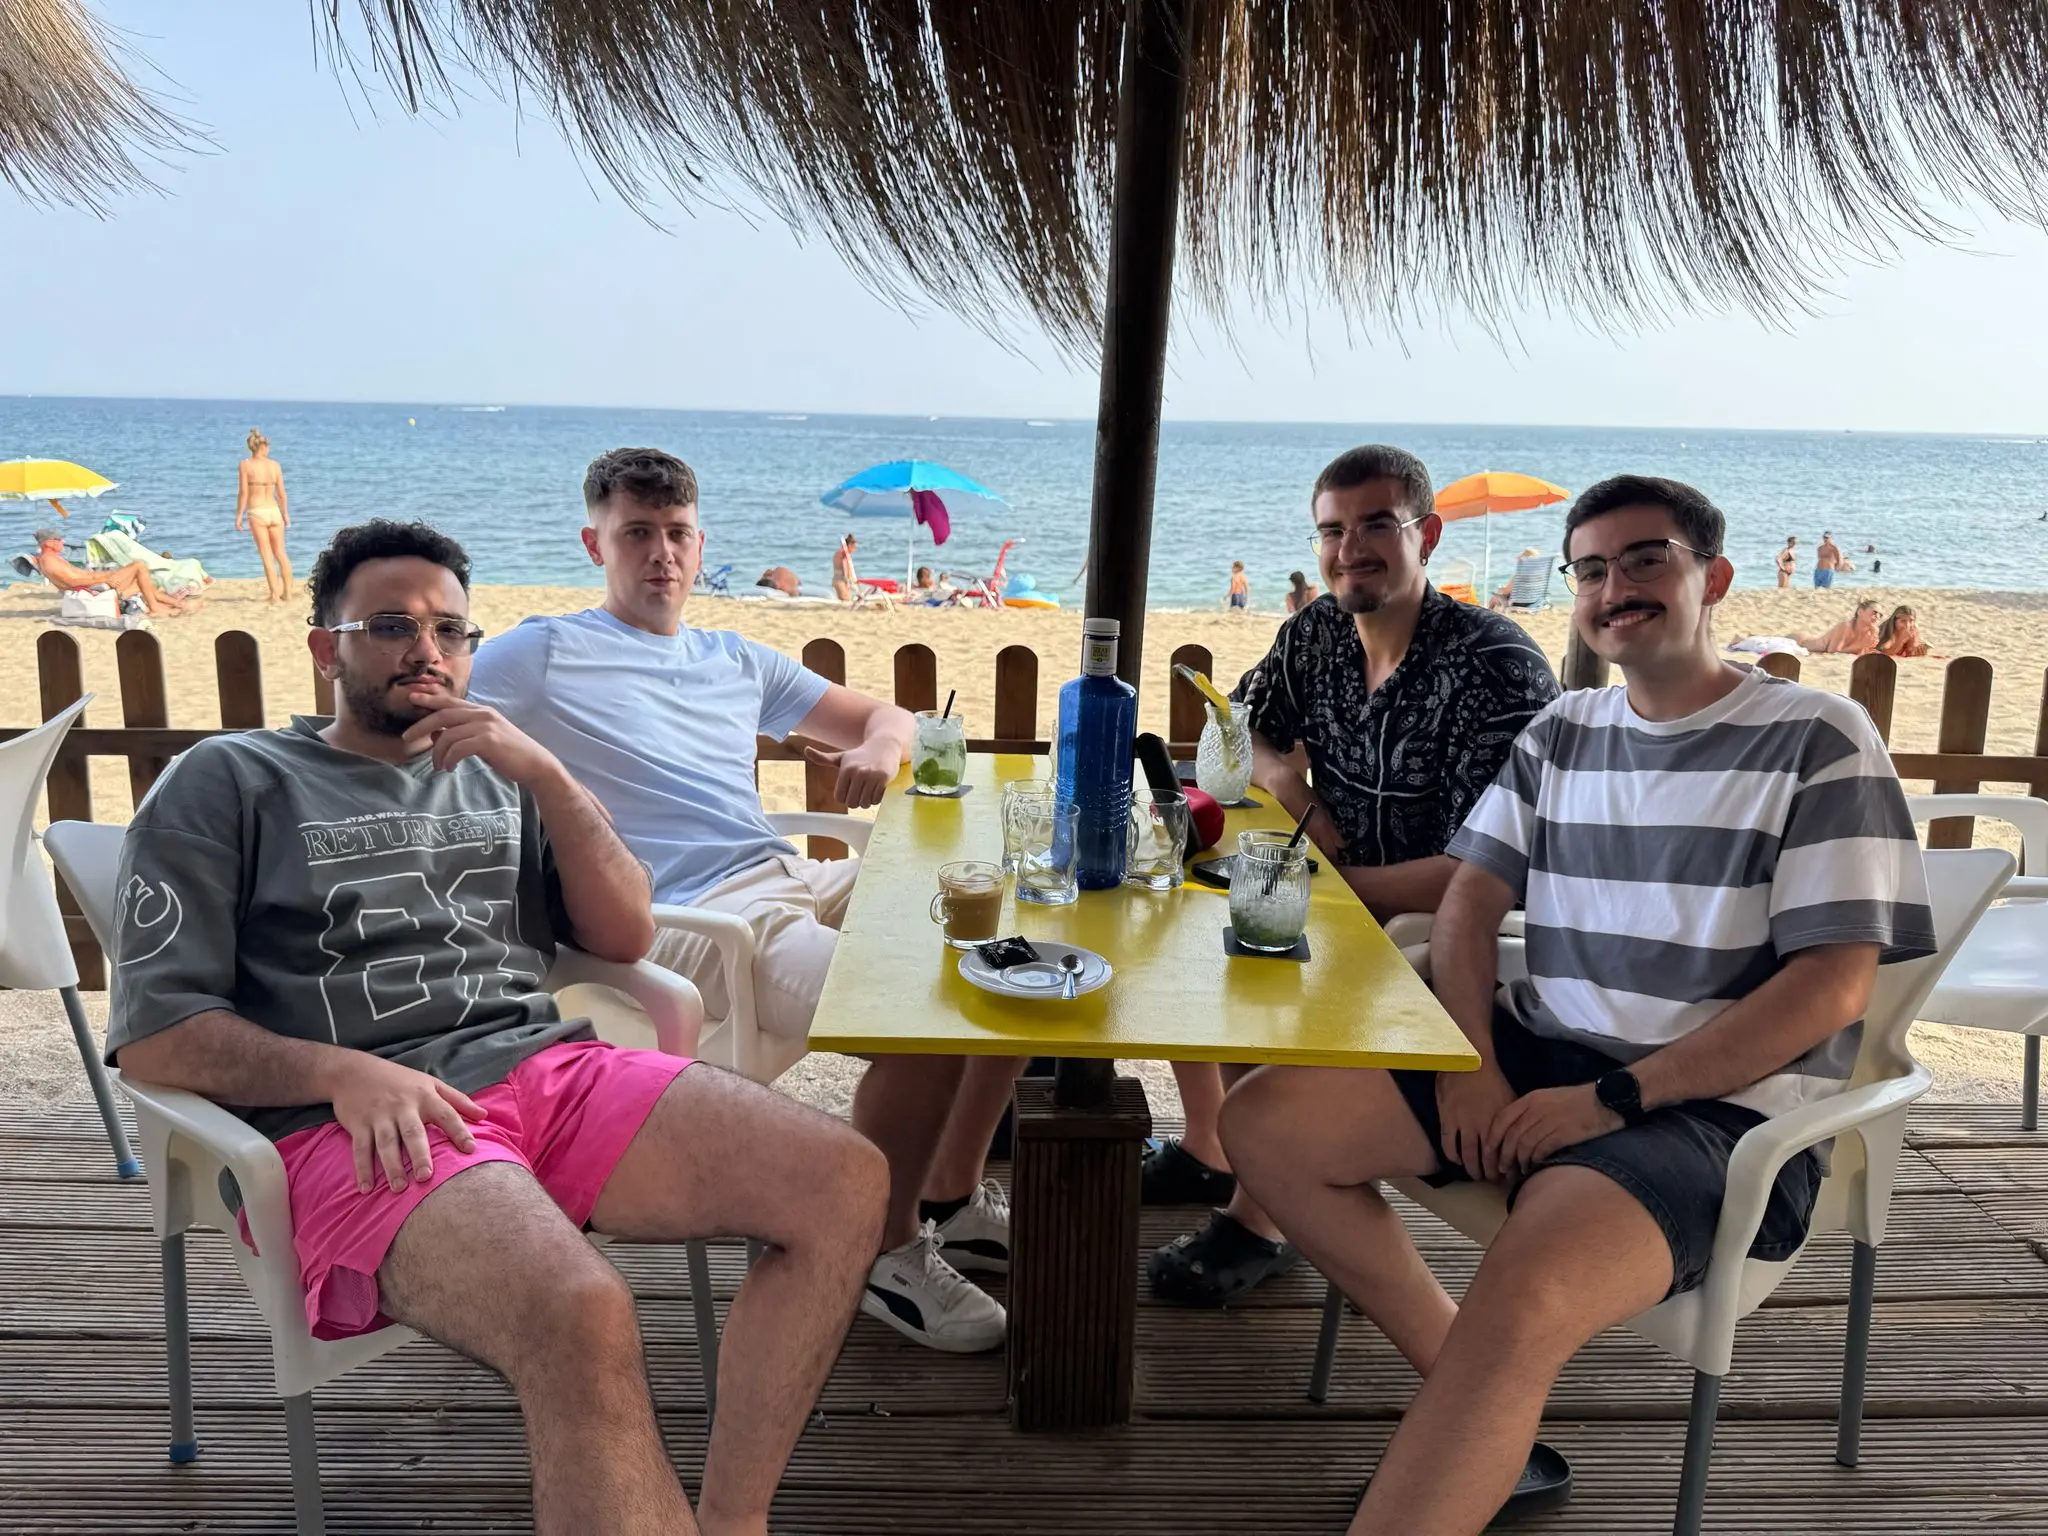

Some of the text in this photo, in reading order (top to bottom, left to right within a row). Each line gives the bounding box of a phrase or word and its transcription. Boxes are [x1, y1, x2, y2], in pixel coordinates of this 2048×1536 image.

[447, 816, 471, 830] OF
[301, 818, 449, 858] RETURN
[448, 826, 487, 842] THE
